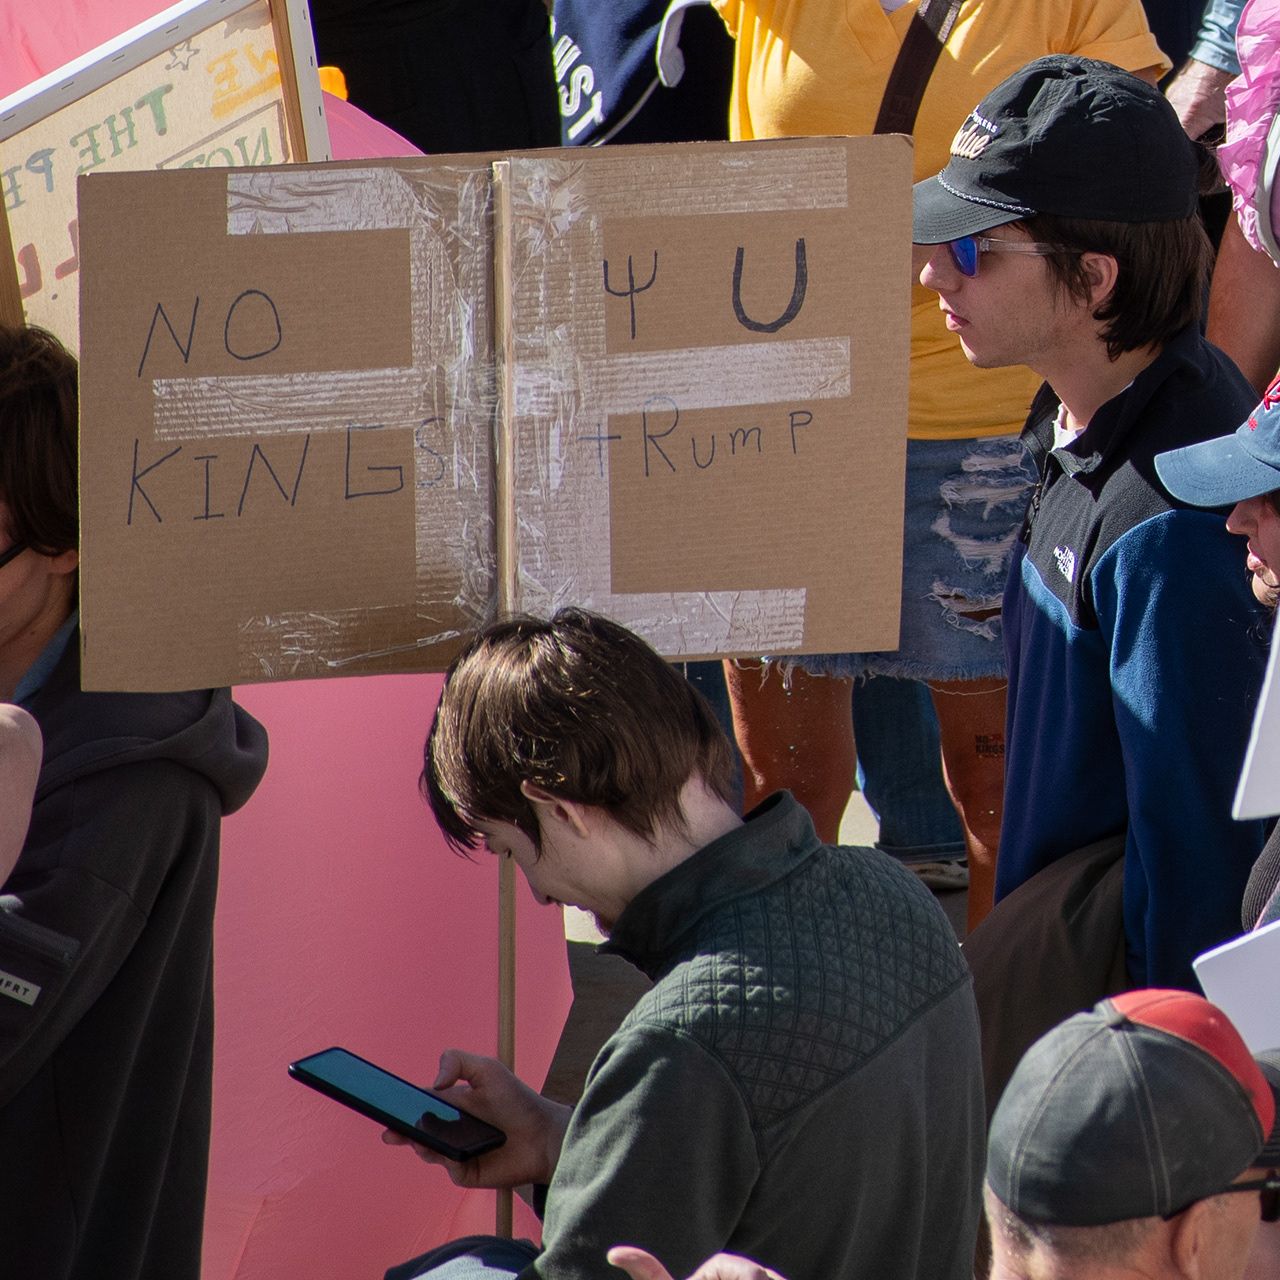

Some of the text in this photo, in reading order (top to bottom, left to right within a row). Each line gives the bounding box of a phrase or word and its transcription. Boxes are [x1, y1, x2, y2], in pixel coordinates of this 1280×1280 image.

[732, 238, 808, 333] U
[137, 290, 282, 378] NO
[127, 418, 448, 525] KINGS
[975, 734, 989, 744] NO
[975, 743, 1005, 754] KINGS
[0, 977, 30, 997] FRT
